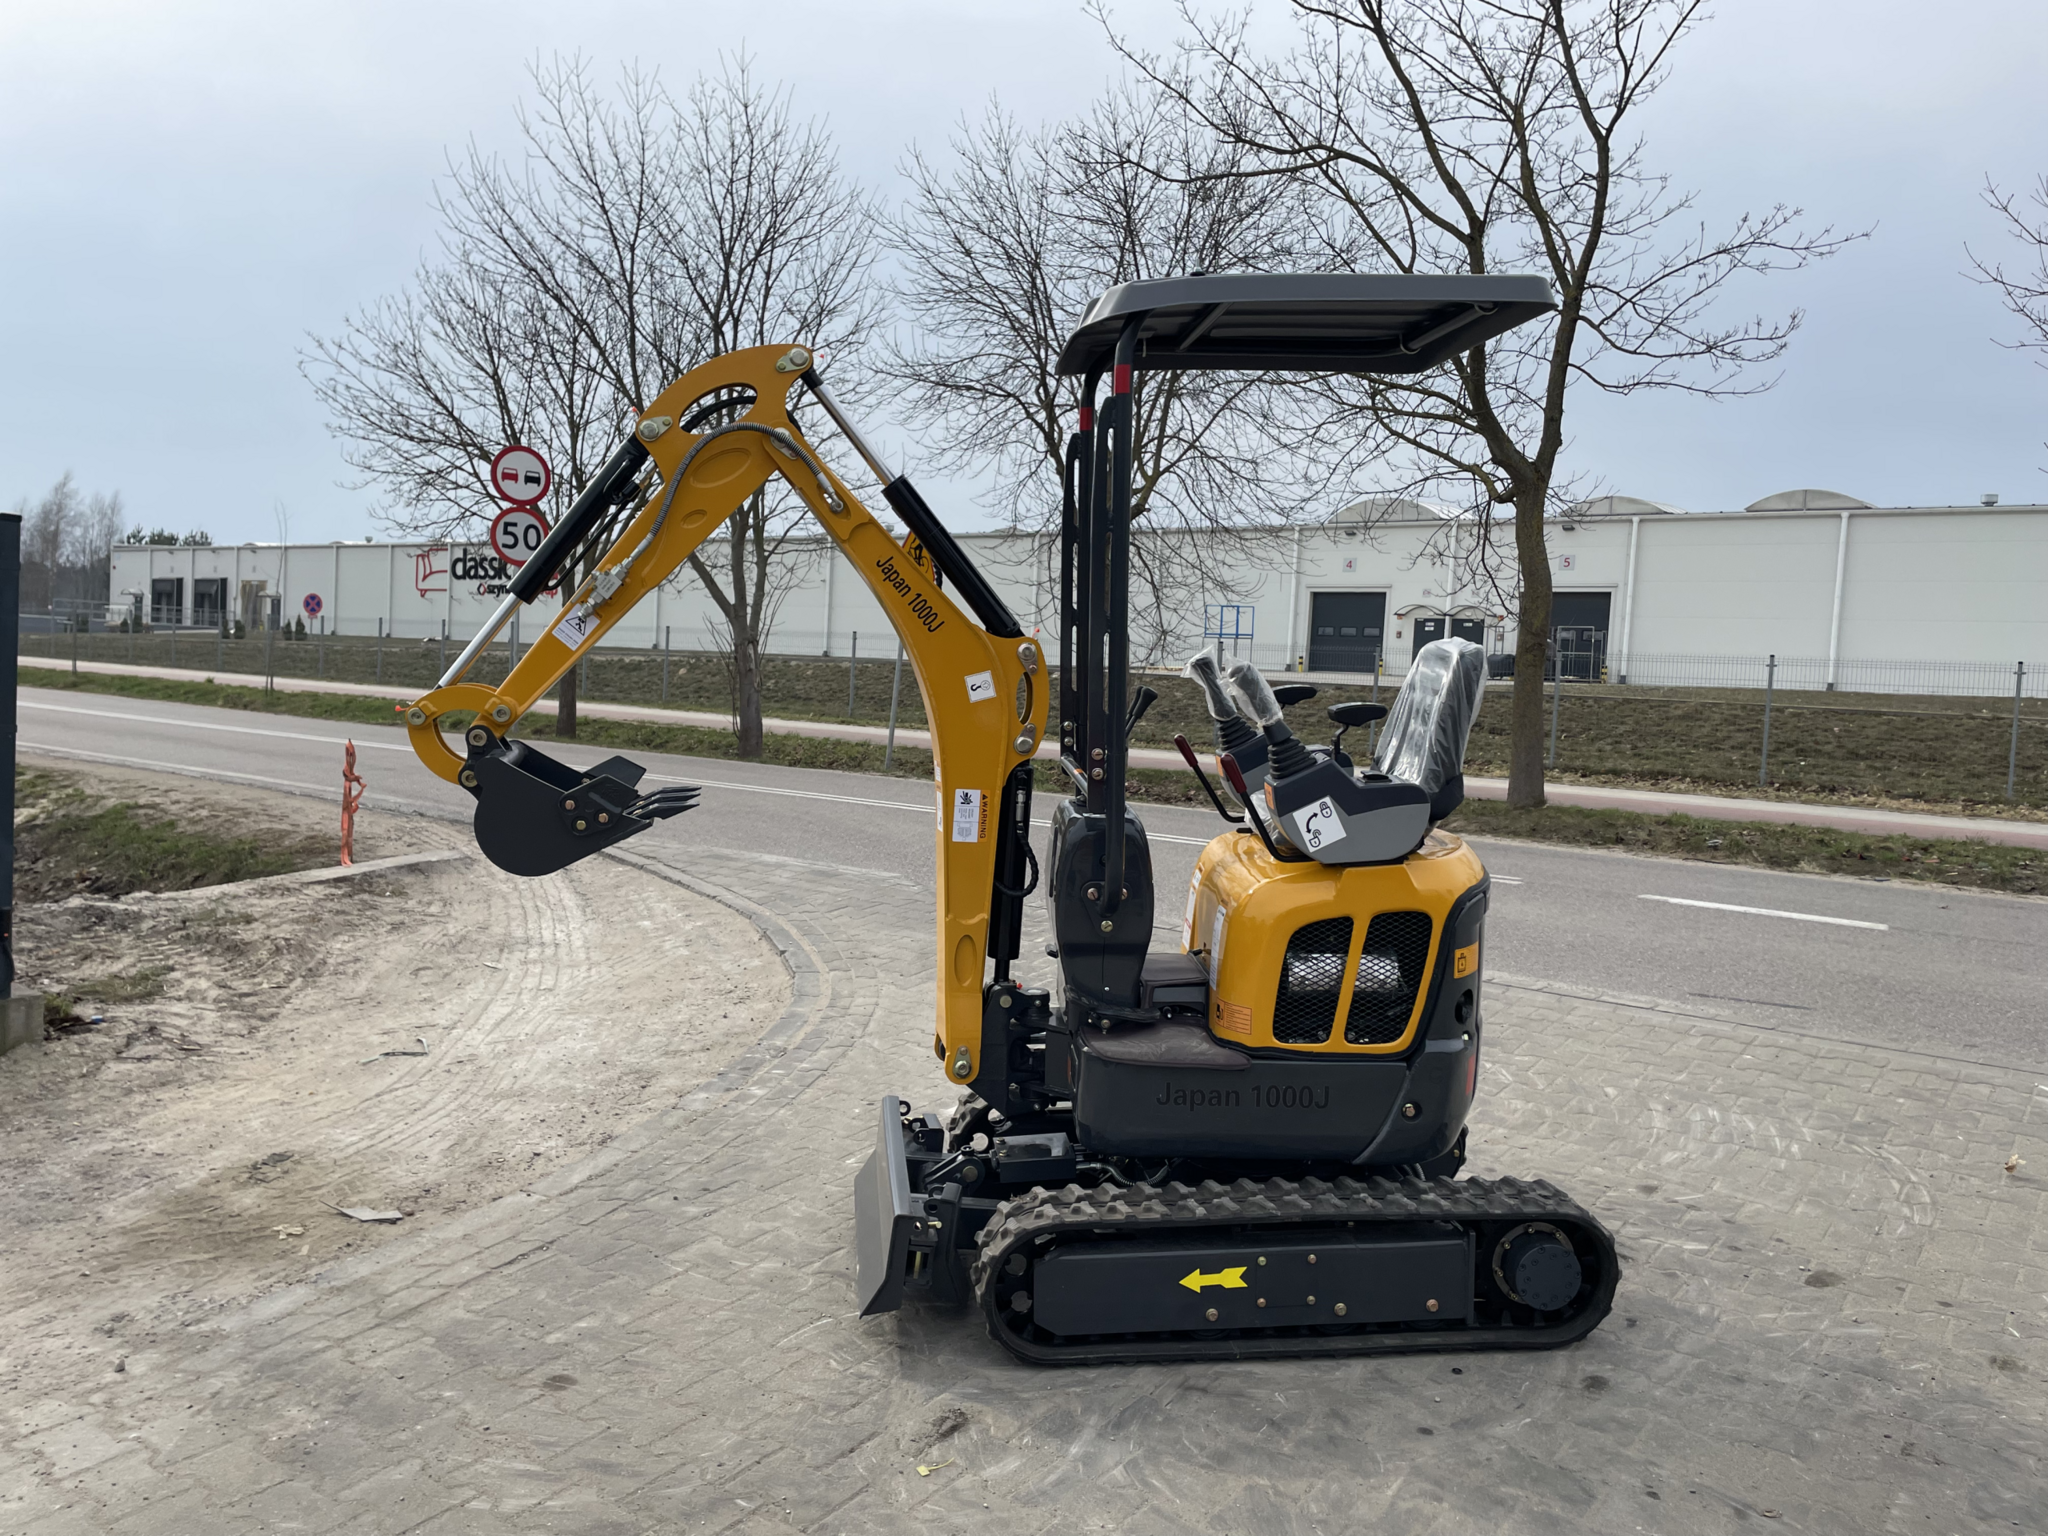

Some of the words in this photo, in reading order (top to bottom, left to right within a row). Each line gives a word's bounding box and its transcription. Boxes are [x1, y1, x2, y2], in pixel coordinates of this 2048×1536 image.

[501, 521, 542, 551] 50
[1345, 560, 1353, 570] 4
[1563, 557, 1571, 568] 5
[876, 556, 911, 598] Japan
[907, 593, 945, 633] 1000J
[980, 801, 989, 839] WARNING
[1156, 1082, 1240, 1111] Japan
[1251, 1085, 1330, 1109] 1000J
